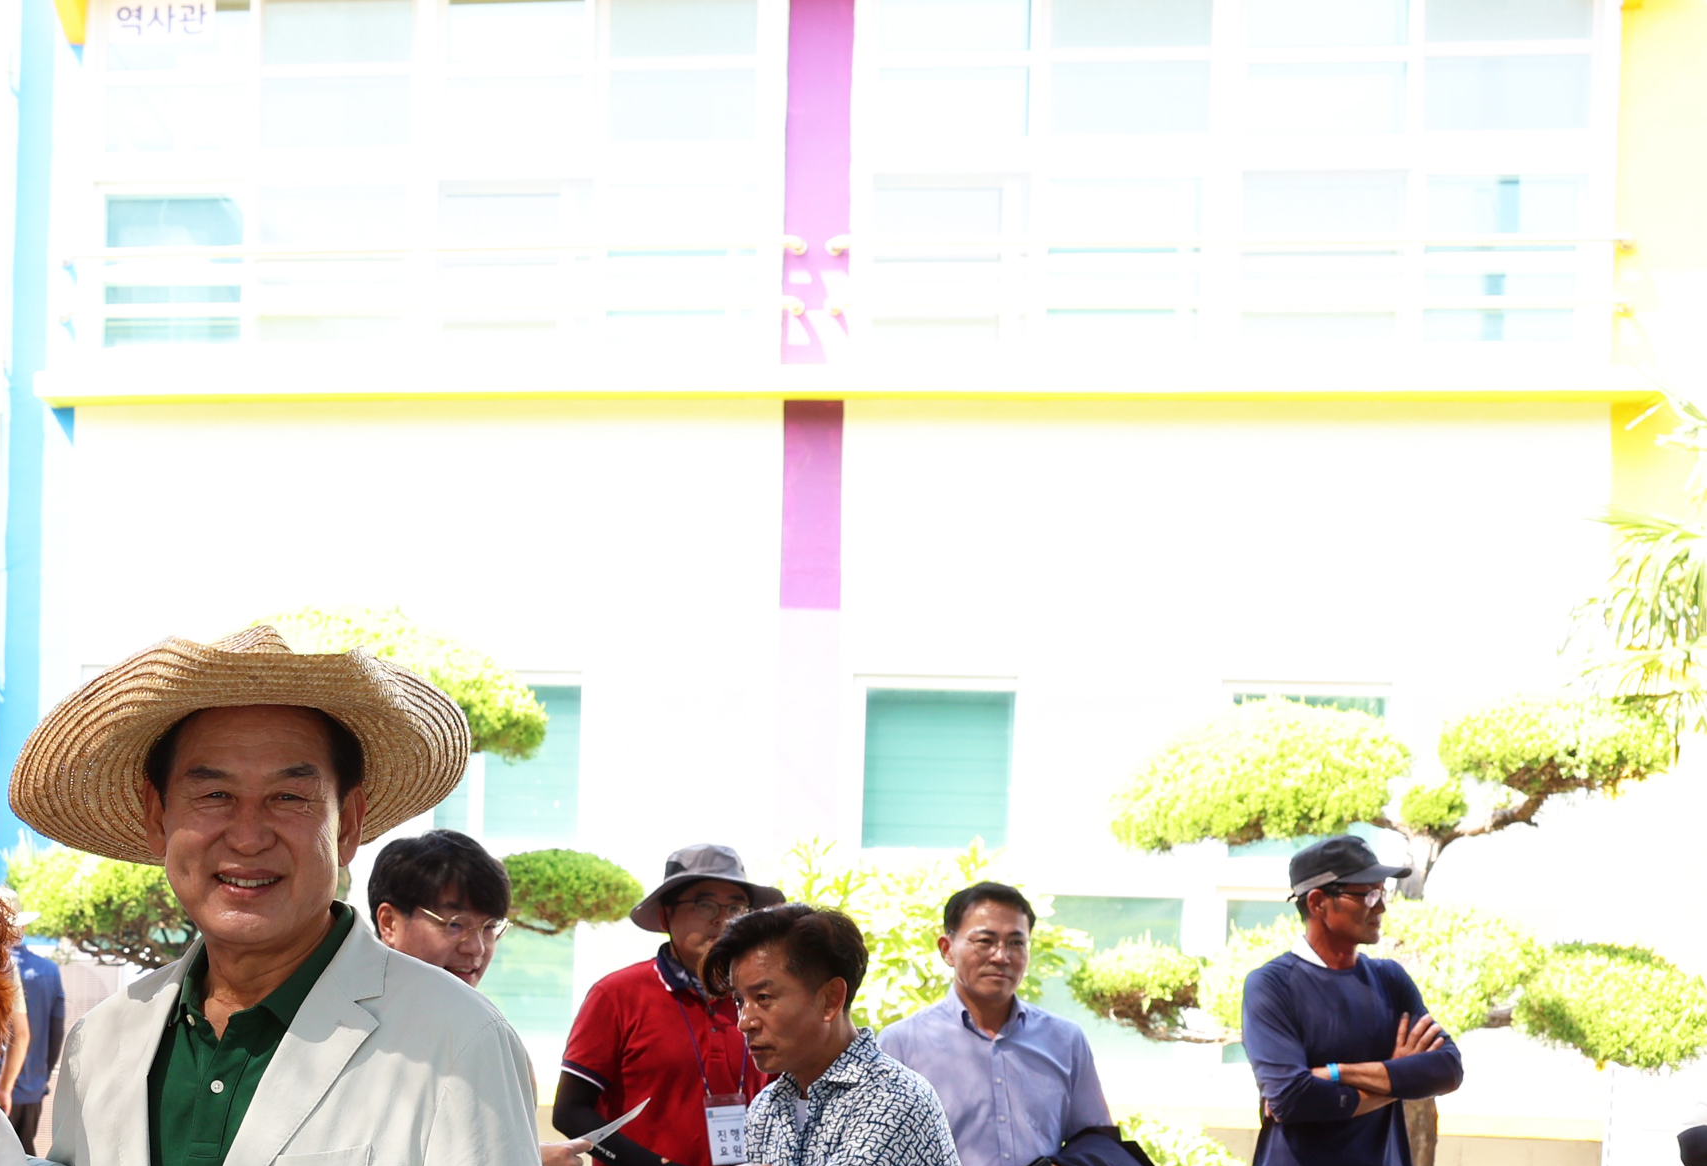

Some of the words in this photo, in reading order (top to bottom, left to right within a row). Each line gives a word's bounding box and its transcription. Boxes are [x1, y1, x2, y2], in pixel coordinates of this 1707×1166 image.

[116, 3, 208, 36] 역사관
[717, 1129, 740, 1143] 진행
[720, 1145, 743, 1158] 요원
